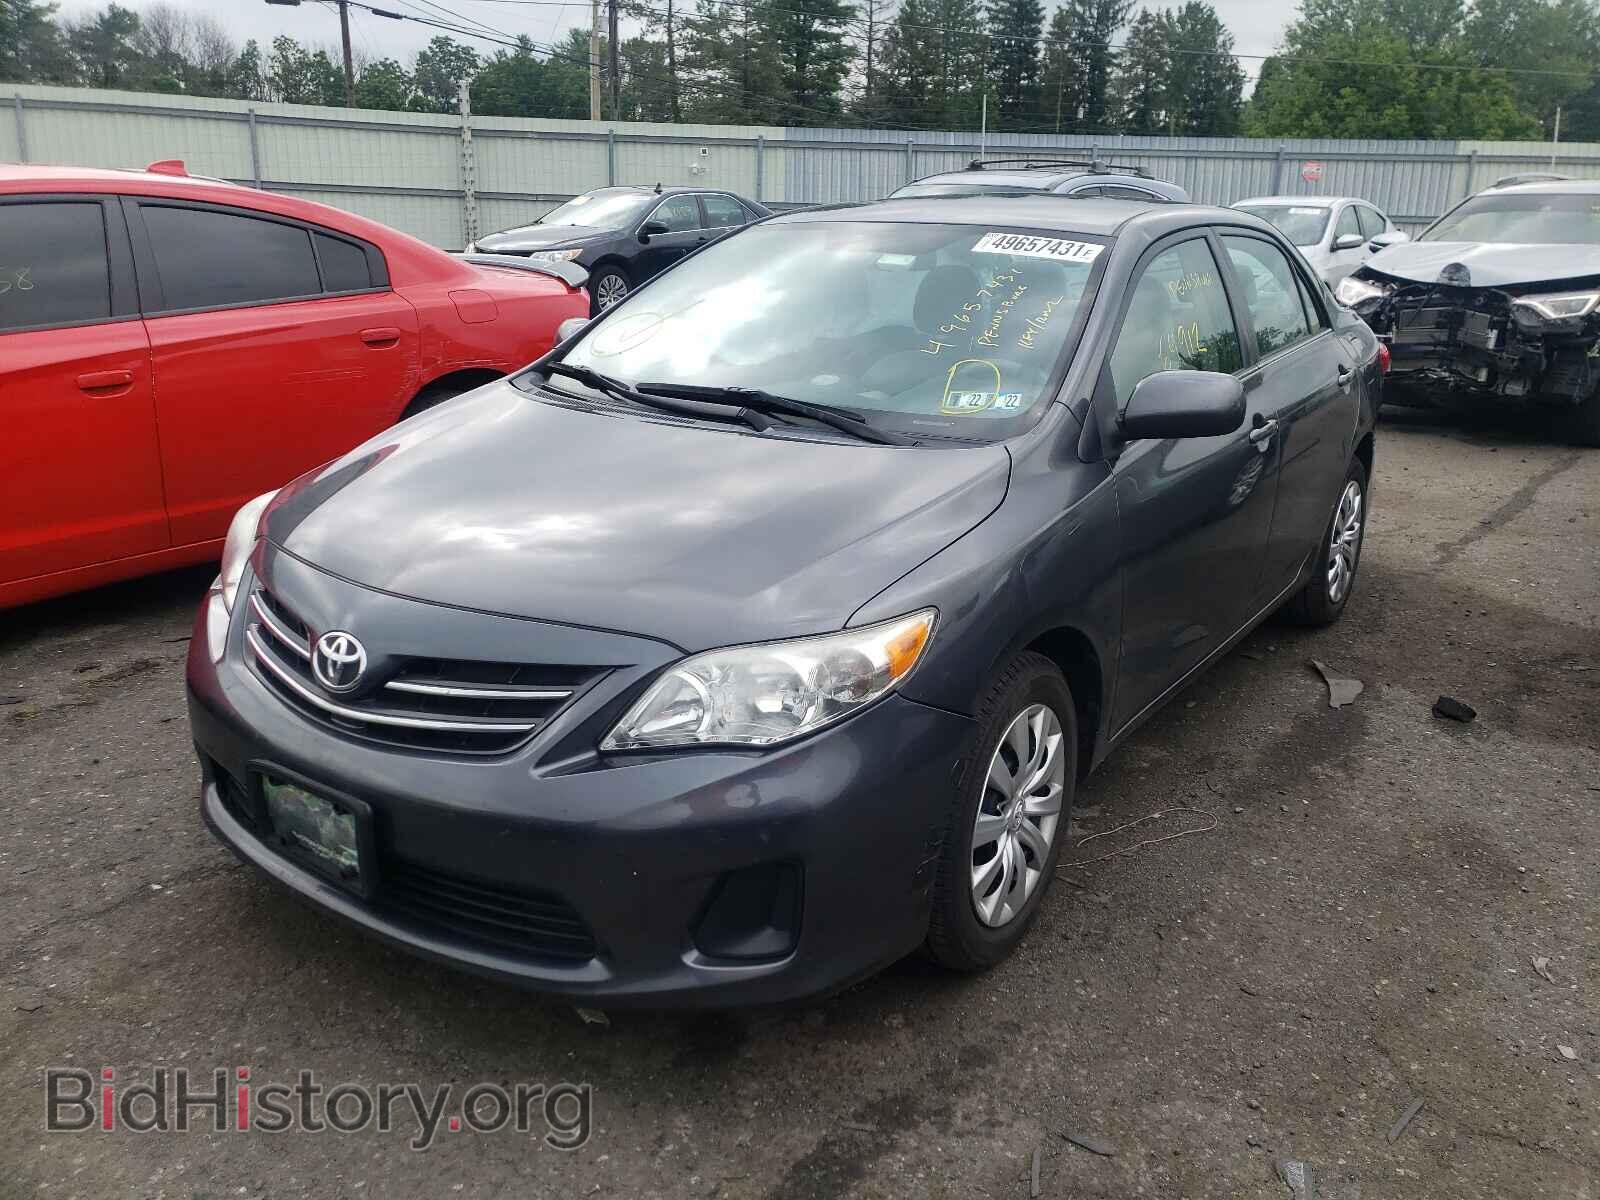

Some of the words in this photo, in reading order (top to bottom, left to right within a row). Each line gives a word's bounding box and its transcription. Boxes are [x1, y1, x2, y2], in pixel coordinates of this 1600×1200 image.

[991, 235, 1085, 257] 49657431
[969, 394, 981, 406] 22
[1006, 395, 1018, 407] 22
